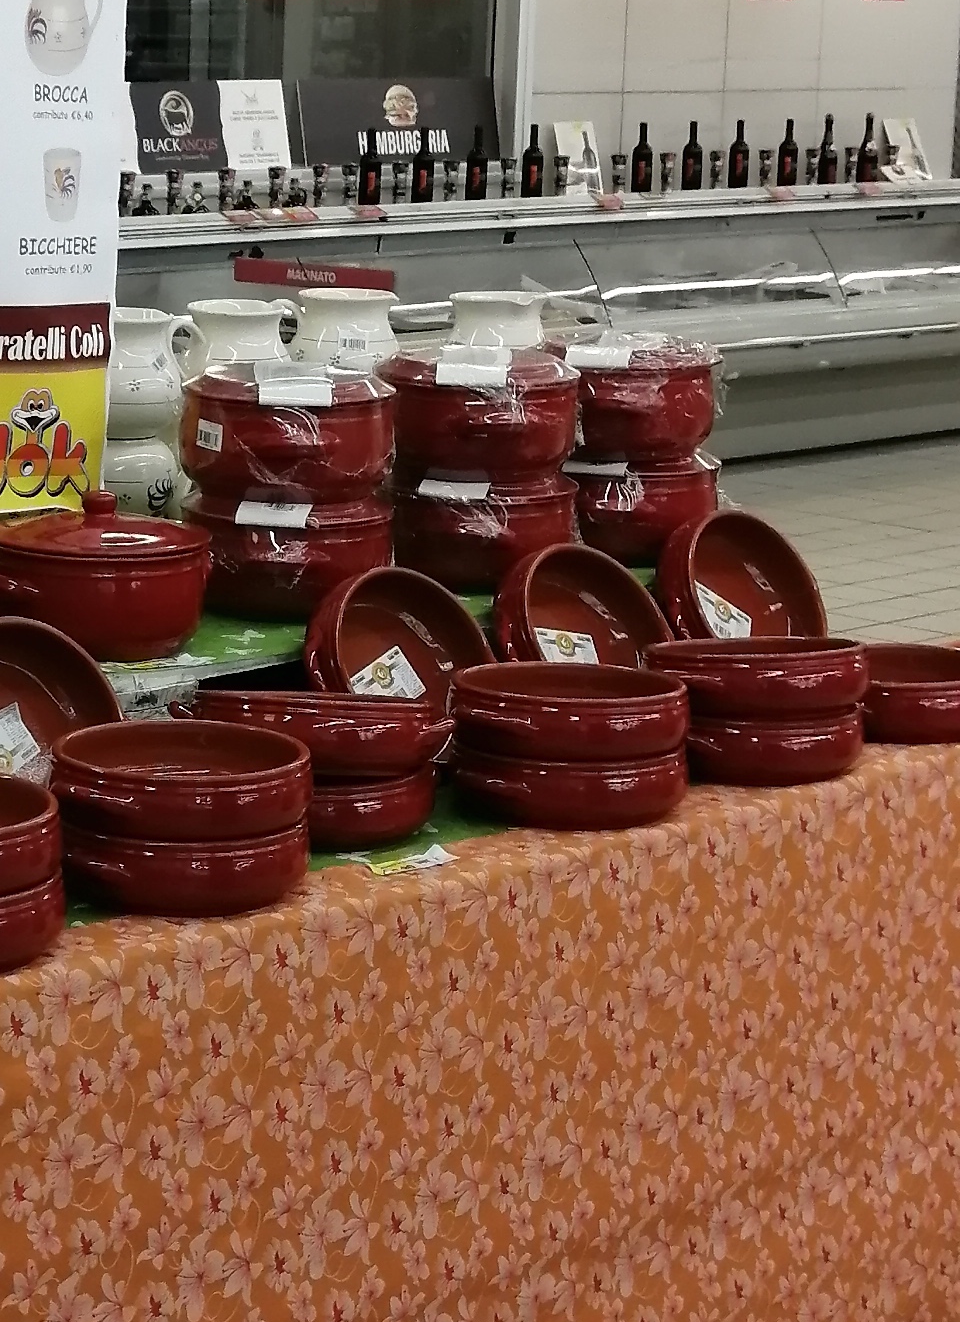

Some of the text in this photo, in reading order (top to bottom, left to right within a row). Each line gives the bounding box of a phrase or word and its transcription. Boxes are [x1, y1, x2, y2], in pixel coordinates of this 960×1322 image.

[34, 83, 88, 104] BROCCA
[357, 128, 450, 155] HMBURGRIA
[18, 236, 97, 256] BICCHIERE
[70, 323, 105, 359] Colì
